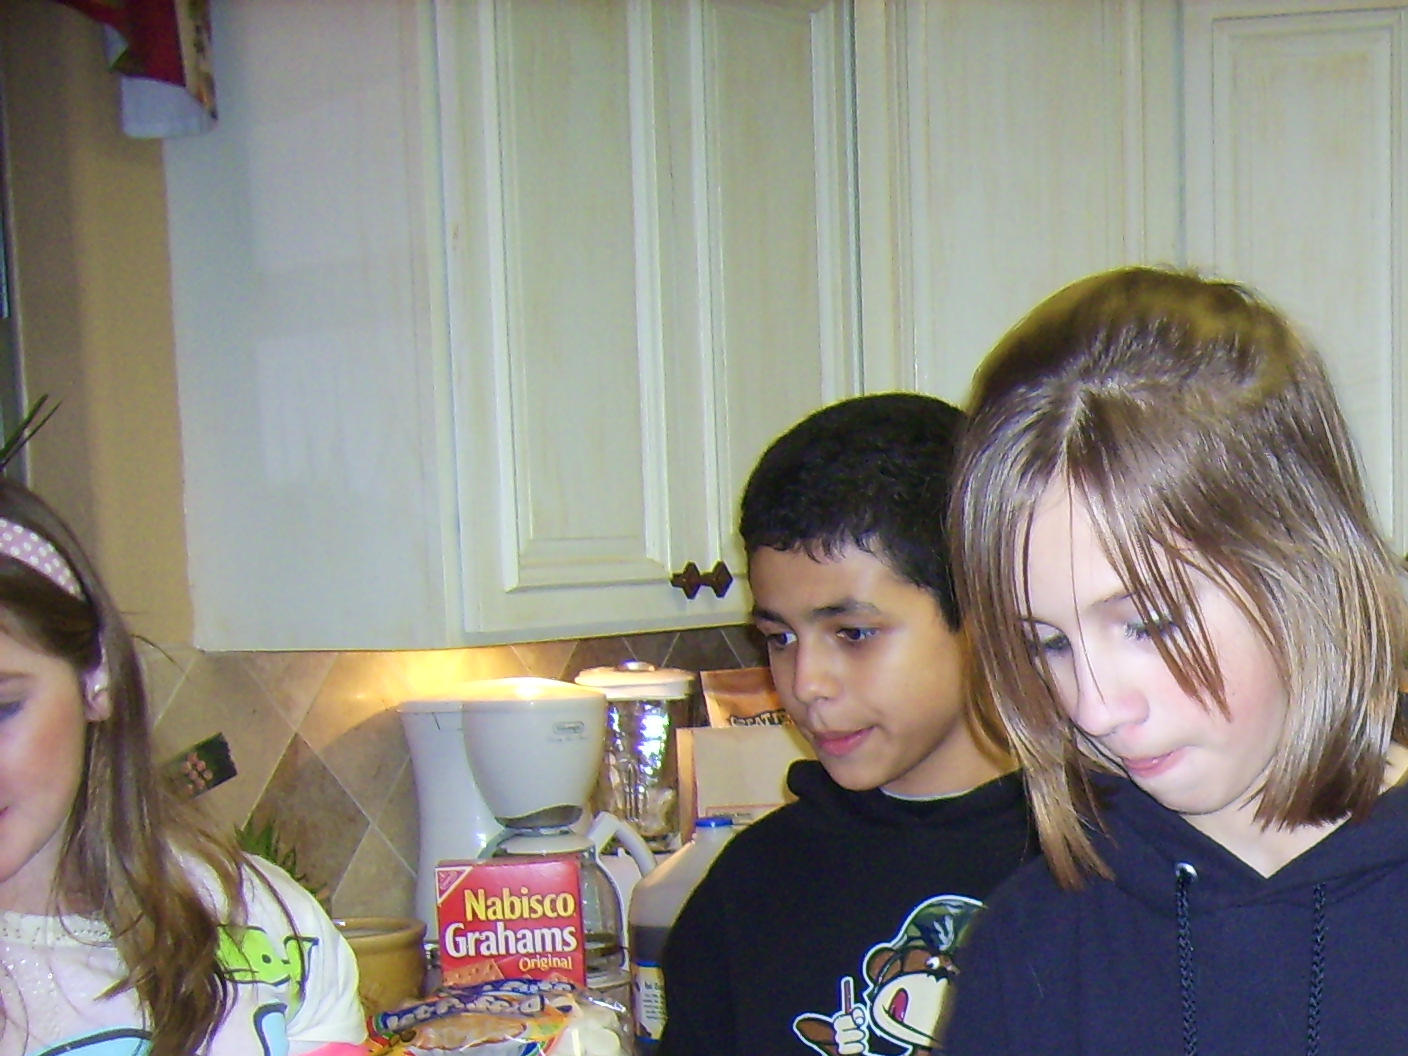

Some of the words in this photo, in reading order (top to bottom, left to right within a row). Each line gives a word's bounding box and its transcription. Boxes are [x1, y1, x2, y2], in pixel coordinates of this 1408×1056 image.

[464, 886, 577, 922] Nabisco
[444, 921, 578, 959] Grahams
[518, 954, 573, 972] Original
